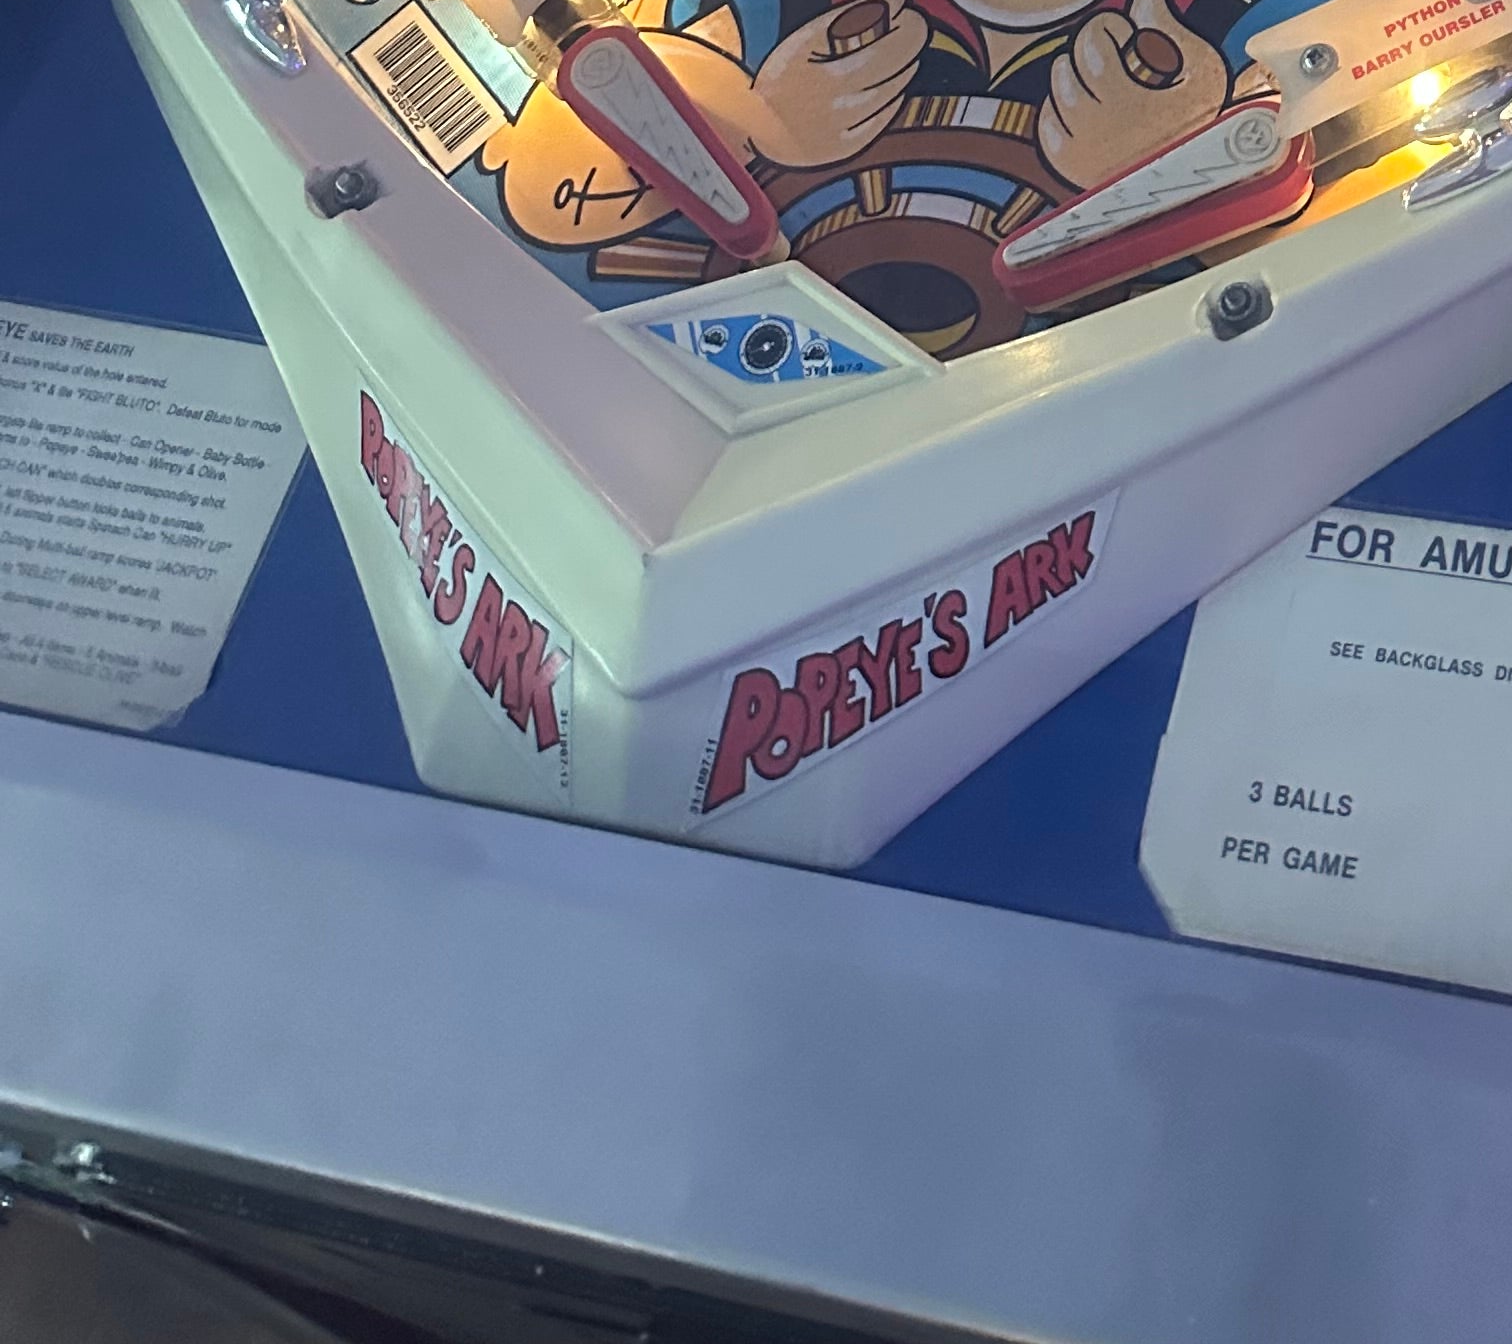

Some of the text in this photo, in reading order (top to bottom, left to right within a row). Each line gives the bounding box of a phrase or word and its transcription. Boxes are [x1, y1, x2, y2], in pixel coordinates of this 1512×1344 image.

[1351, 45, 1414, 82] BARRY
[1419, 0, 1507, 49] OURSLER
[387, 84, 426, 132] 356522
[28, 330, 135, 358] SAVES THE EARTH
[1309, 520, 1396, 565] FOR
[360, 389, 572, 753] POPEYE'S ARK
[701, 510, 1097, 816] POPEYE'S ARK
[1330, 641, 1366, 662] SEE
[1375, 647, 1484, 680] BACKGLASS
[1248, 780, 1355, 818] 3 BALLS
[1221, 836, 1359, 881] PER GAME
